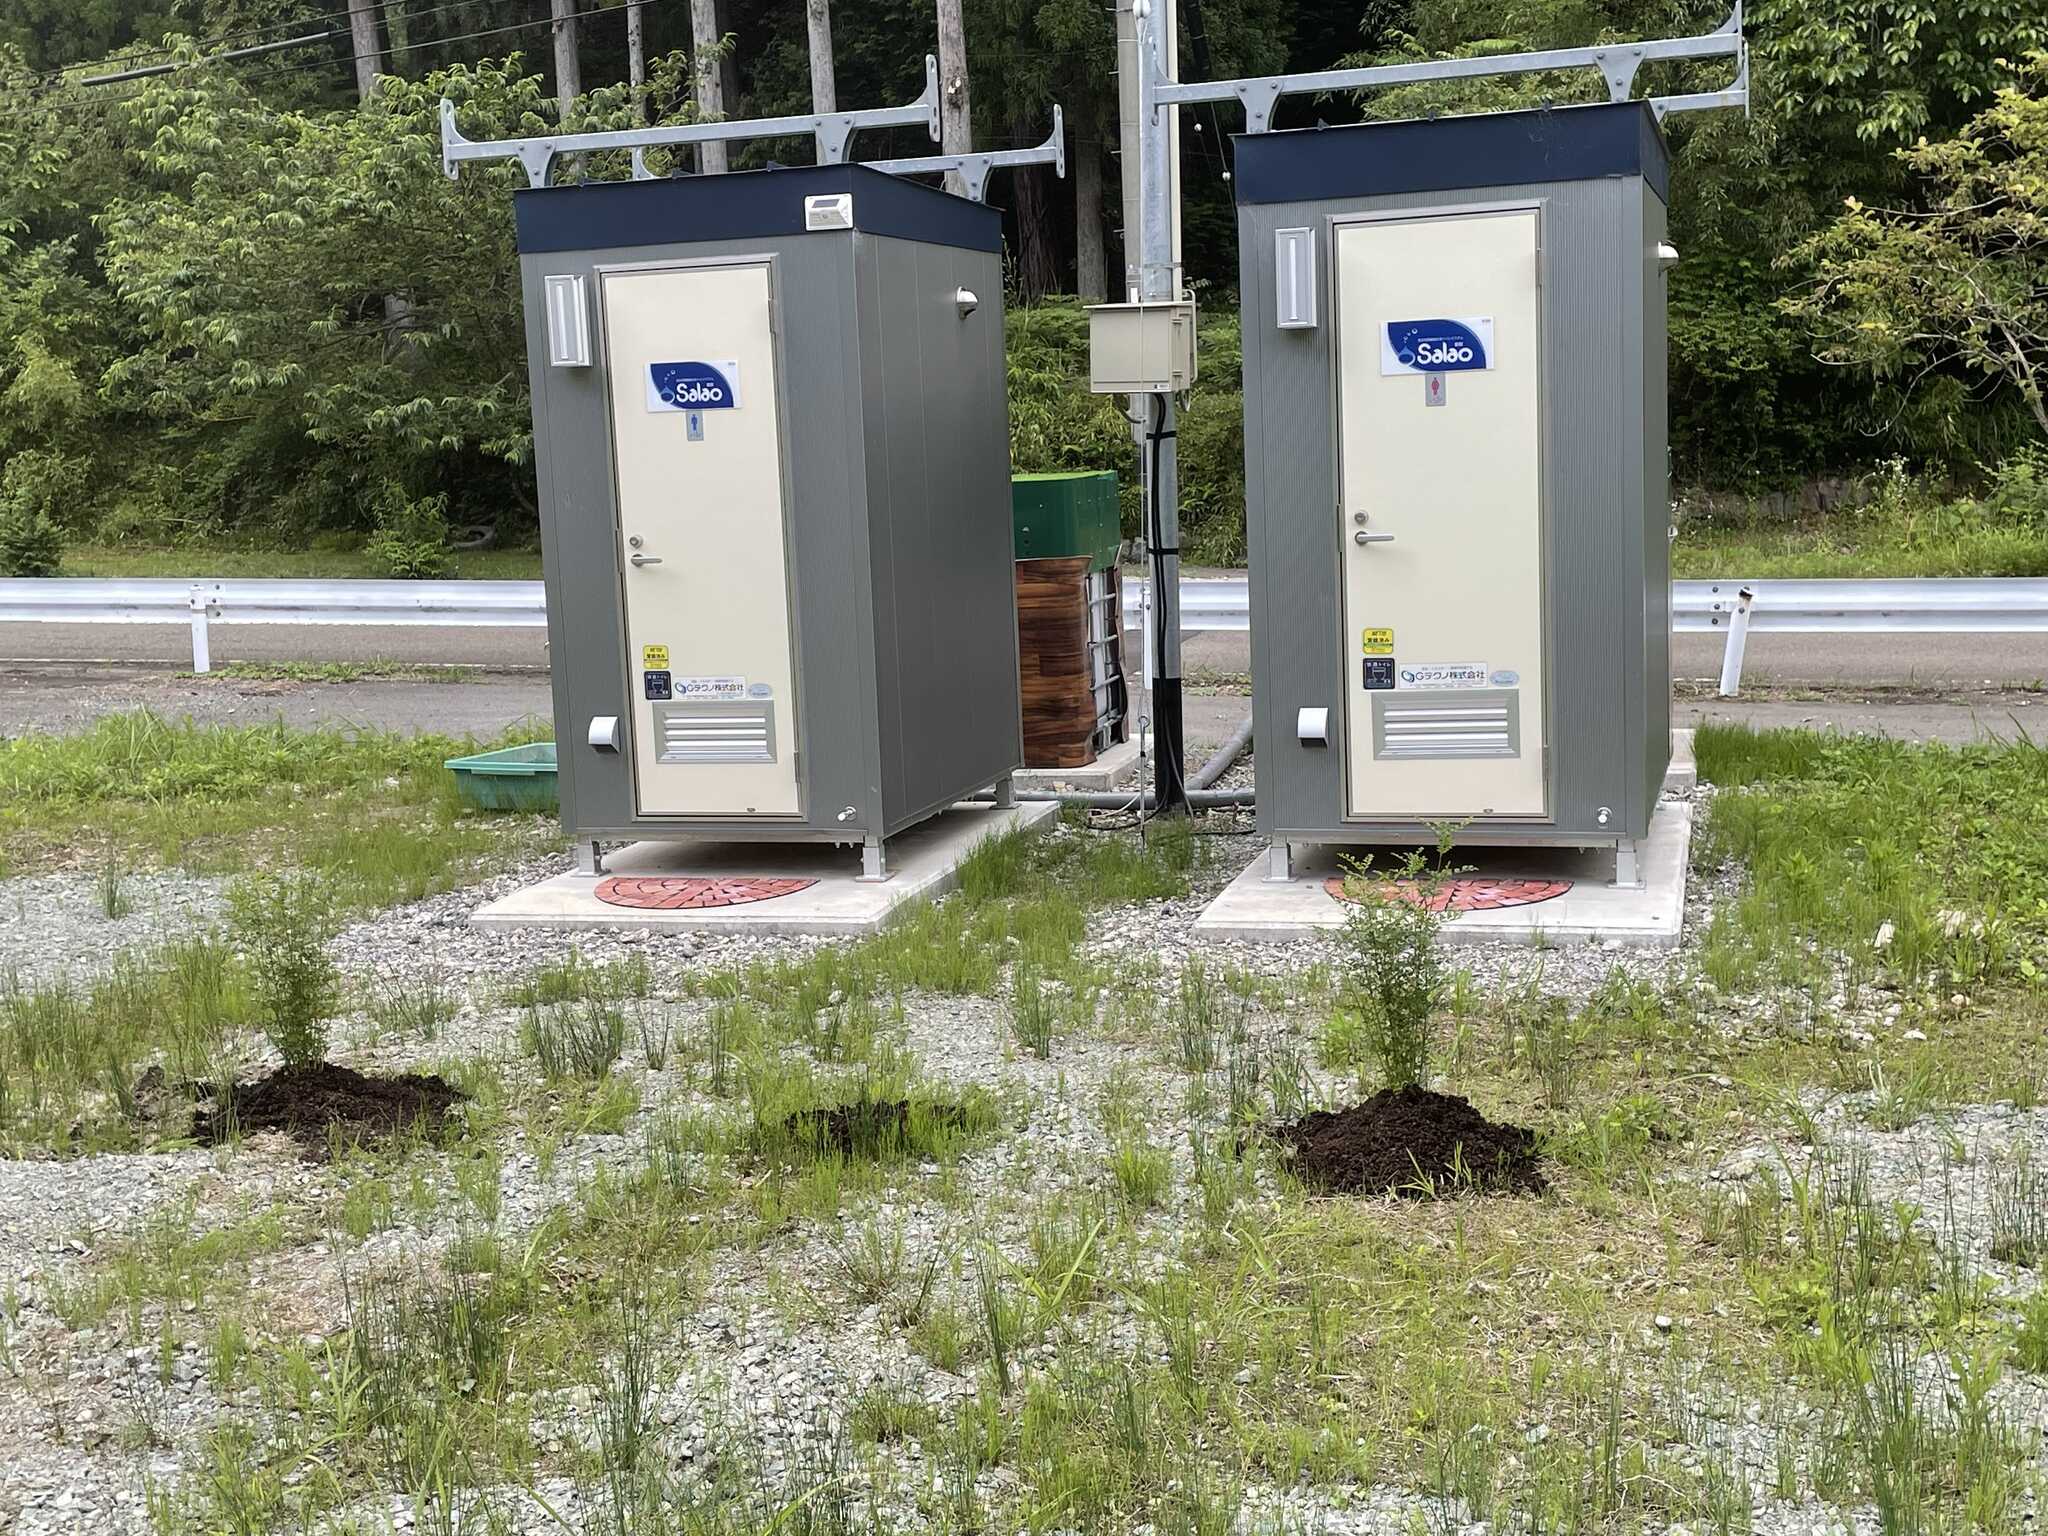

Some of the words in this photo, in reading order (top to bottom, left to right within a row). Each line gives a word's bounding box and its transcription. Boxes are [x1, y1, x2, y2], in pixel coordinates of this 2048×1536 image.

[1415, 670, 1486, 681] Gテクノ株式会社
[686, 683, 745, 693] Gテクノ株式会社
